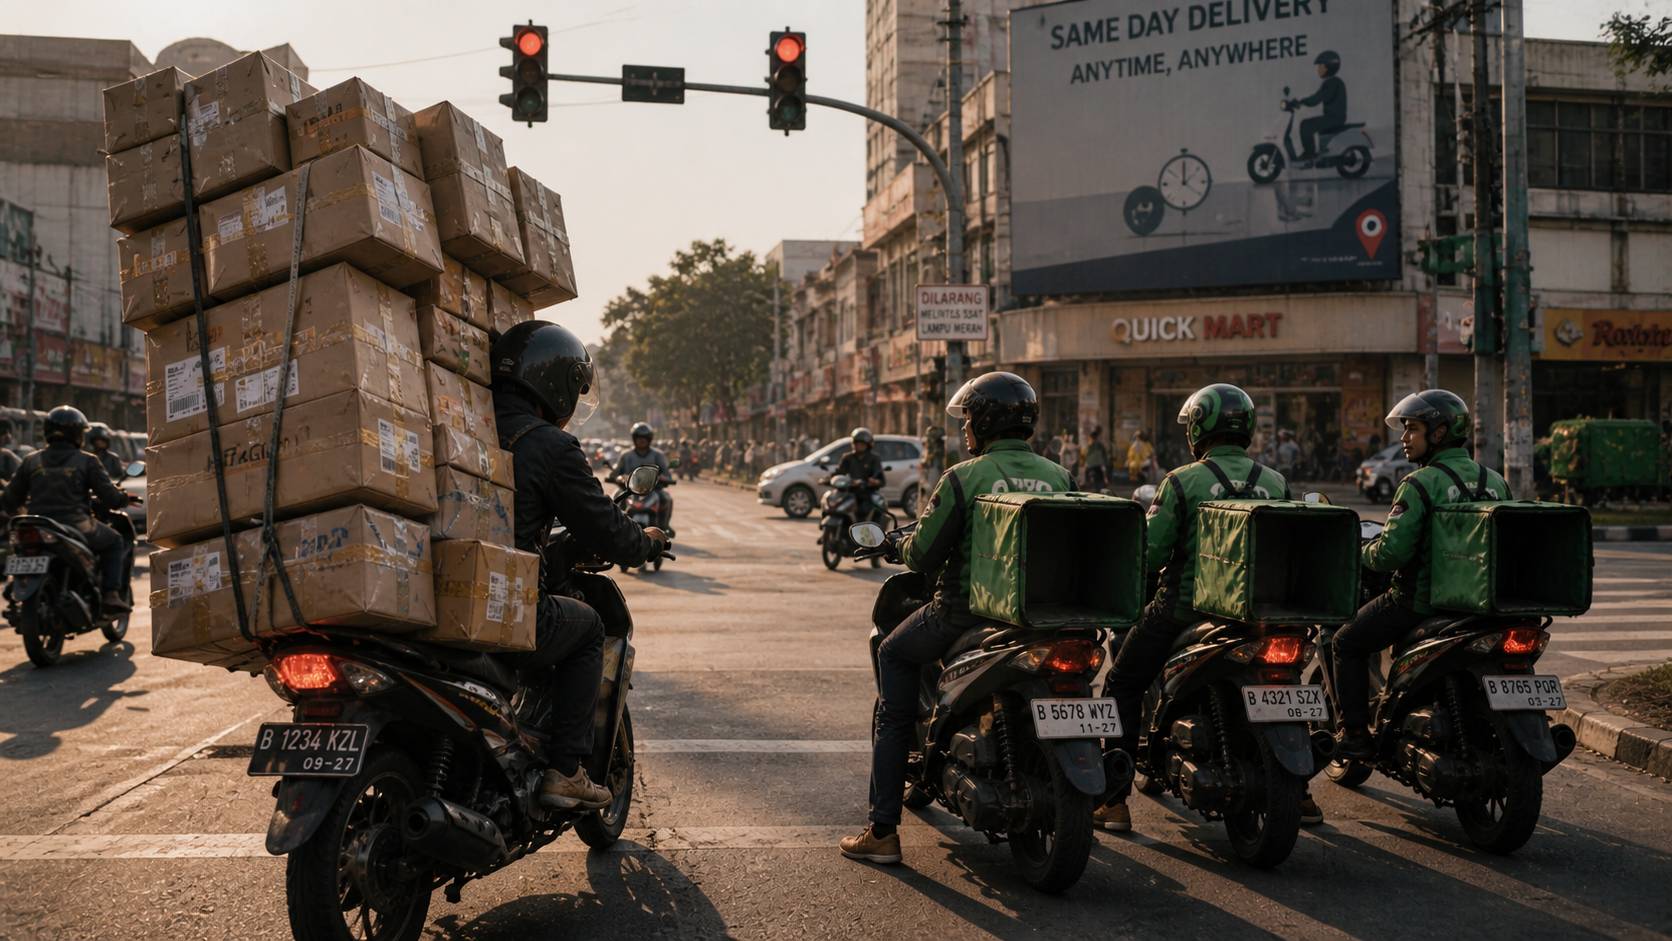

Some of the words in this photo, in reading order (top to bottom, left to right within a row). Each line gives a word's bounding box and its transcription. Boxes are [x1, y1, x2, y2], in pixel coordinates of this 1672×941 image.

[1051, 17, 1120, 50] SAME
[1128, 8, 1180, 40] DAY
[1189, 0, 1330, 31] DELIVERY
[1070, 52, 1172, 84] ANYTIME,
[1177, 35, 1308, 71] ANYWHERE
[921, 291, 982, 305] DILARANG
[921, 323, 951, 334] LAMPU
[1111, 316, 1196, 345] QUICK
[1202, 312, 1283, 340] MART
[1488, 680, 1497, 694] B
[1501, 680, 1531, 694] 8765
[1248, 691, 1256, 705] B
[1262, 690, 1292, 705] 4321
[1296, 690, 1321, 704] SZX
[1037, 705, 1046, 720] B
[1051, 704, 1085, 720] 5678
[1088, 704, 1116, 719] WYZ
[1080, 723, 1116, 733] 11-27
[260, 729, 274, 750] B
[281, 729, 322, 750] 1234
[326, 730, 359, 752] KZL
[303, 757, 354, 771] 09-27
